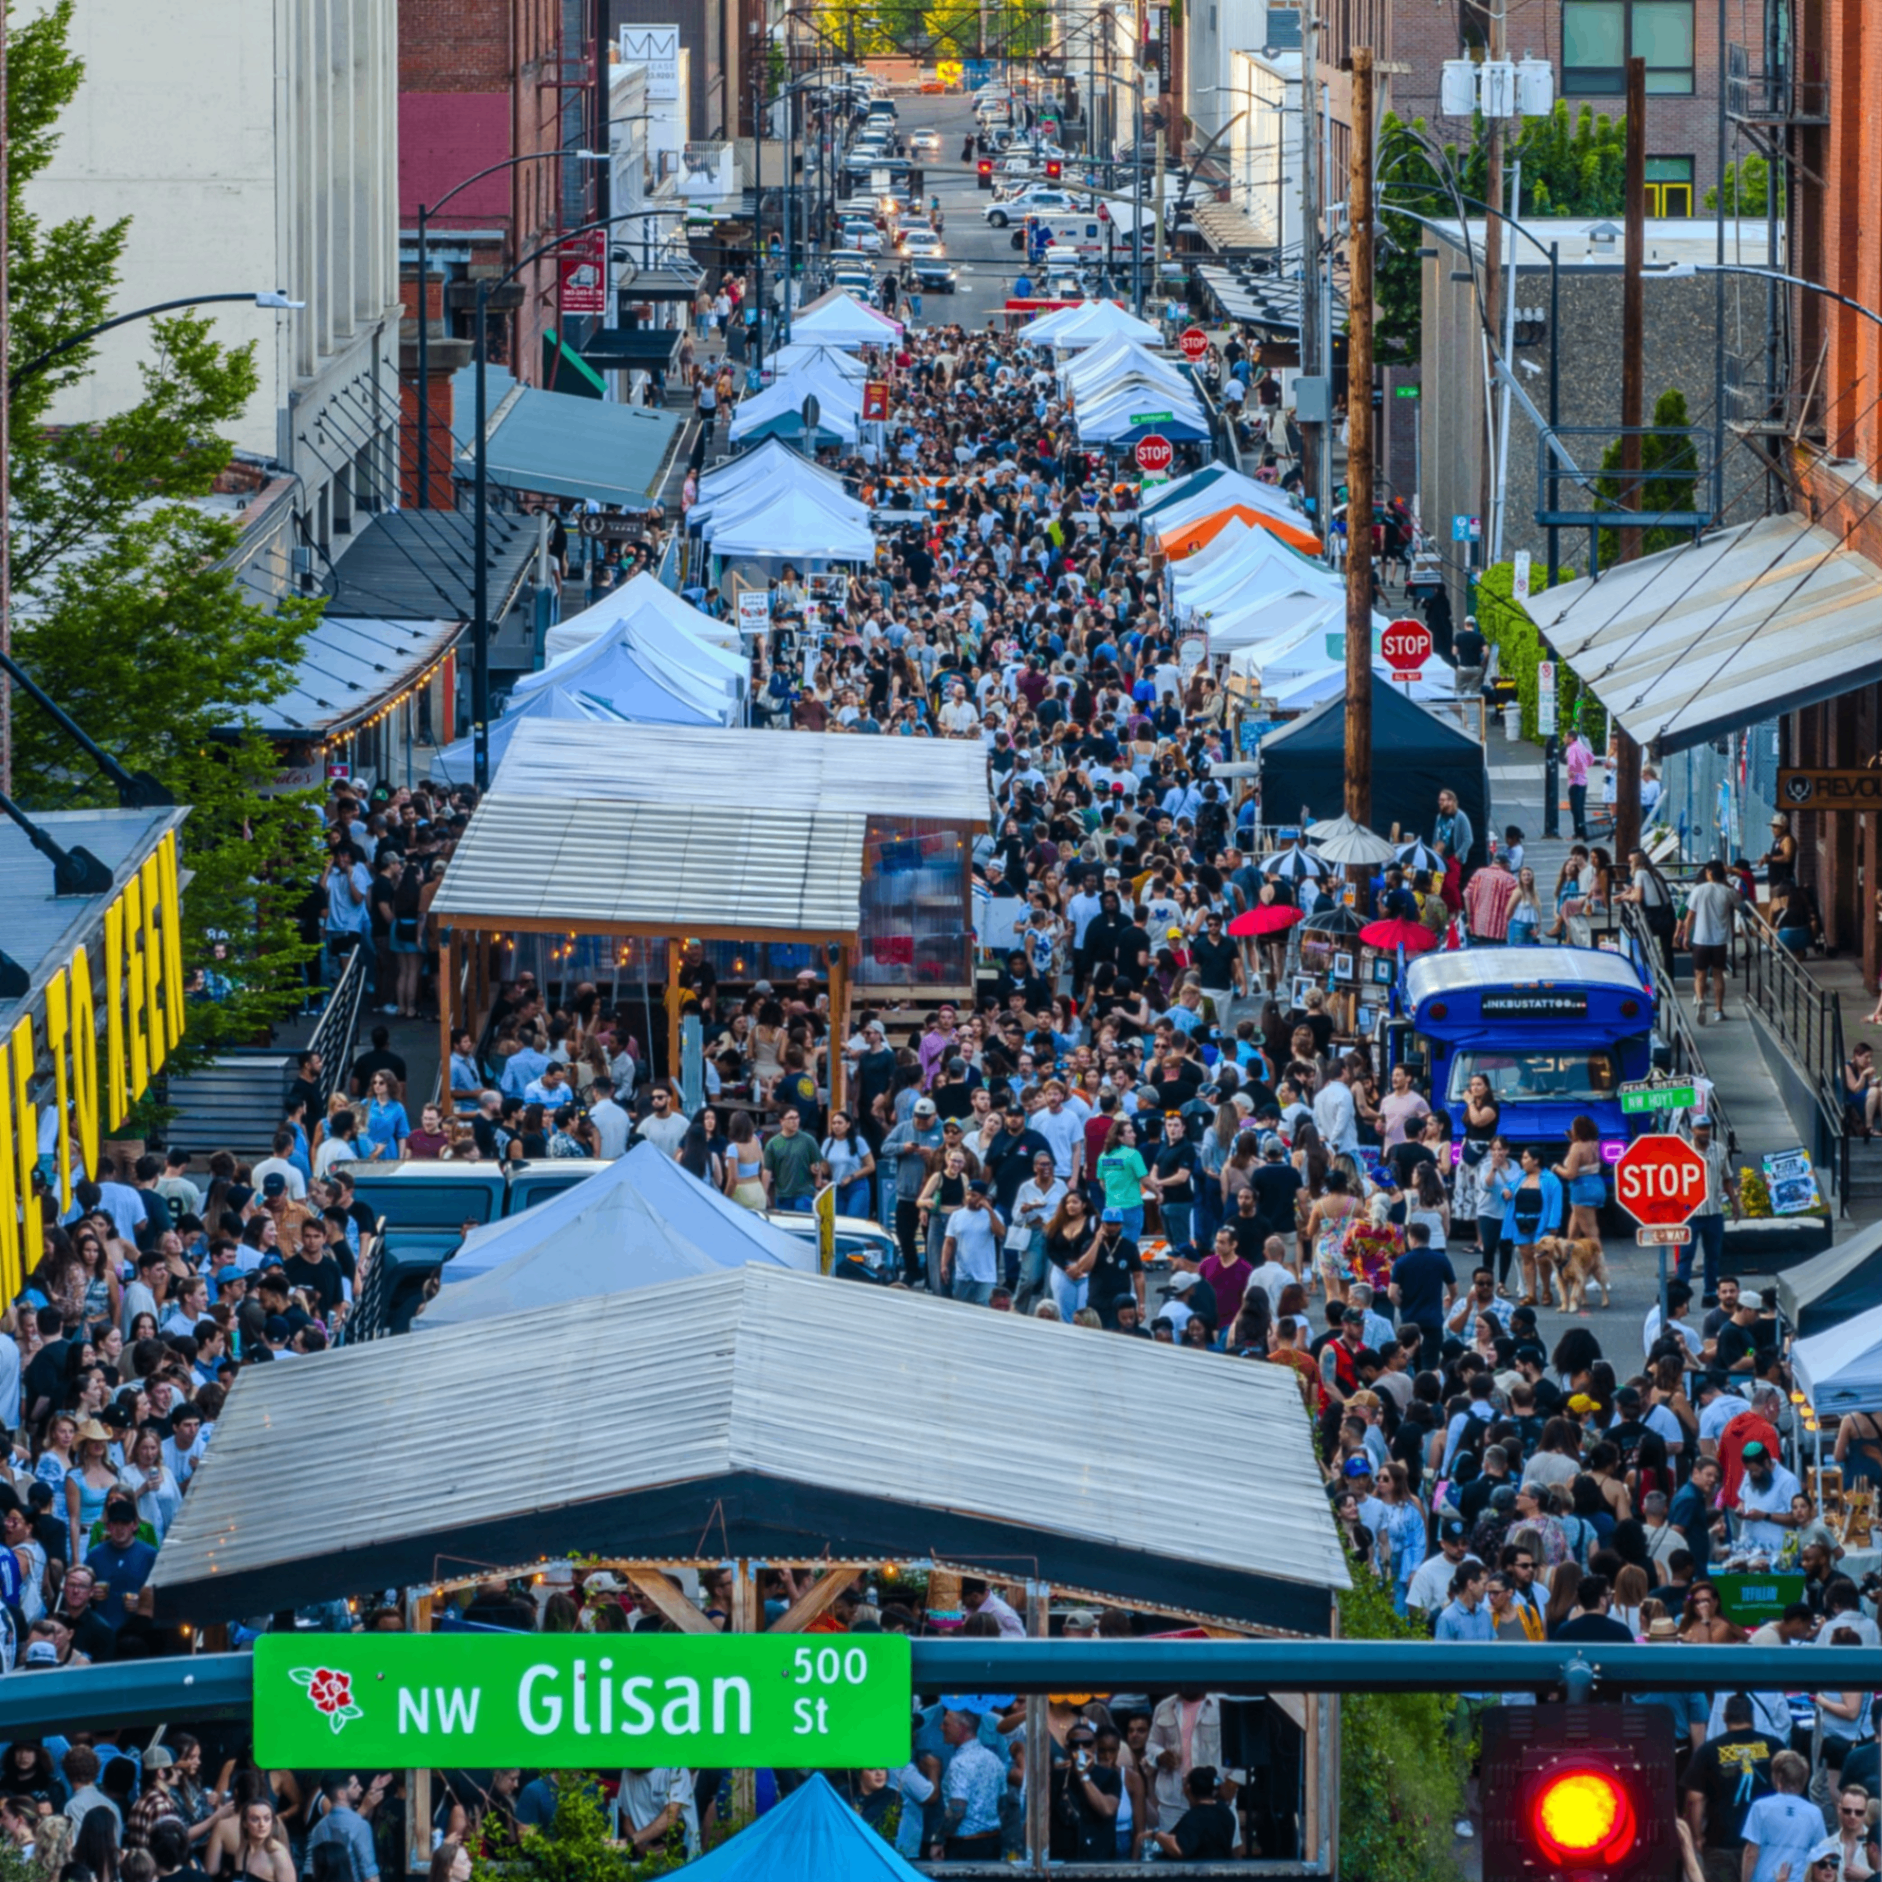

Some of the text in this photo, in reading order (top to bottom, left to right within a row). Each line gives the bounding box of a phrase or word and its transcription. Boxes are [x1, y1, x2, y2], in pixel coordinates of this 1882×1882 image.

[1182, 337, 1207, 349] STOP
[1138, 446, 1170, 461] STOP
[1384, 635, 1429, 656] STOP
[45, 943, 98, 1215] TO
[105, 828, 186, 1134] KEEN
[1623, 1077, 1692, 1093] PEARL DISTRICT
[1648, 1091, 1674, 1107] HOYT
[1622, 1164, 1700, 1198] STOP
[399, 1648, 868, 1735] NW Glisan 500
[794, 1697, 829, 1734] St
